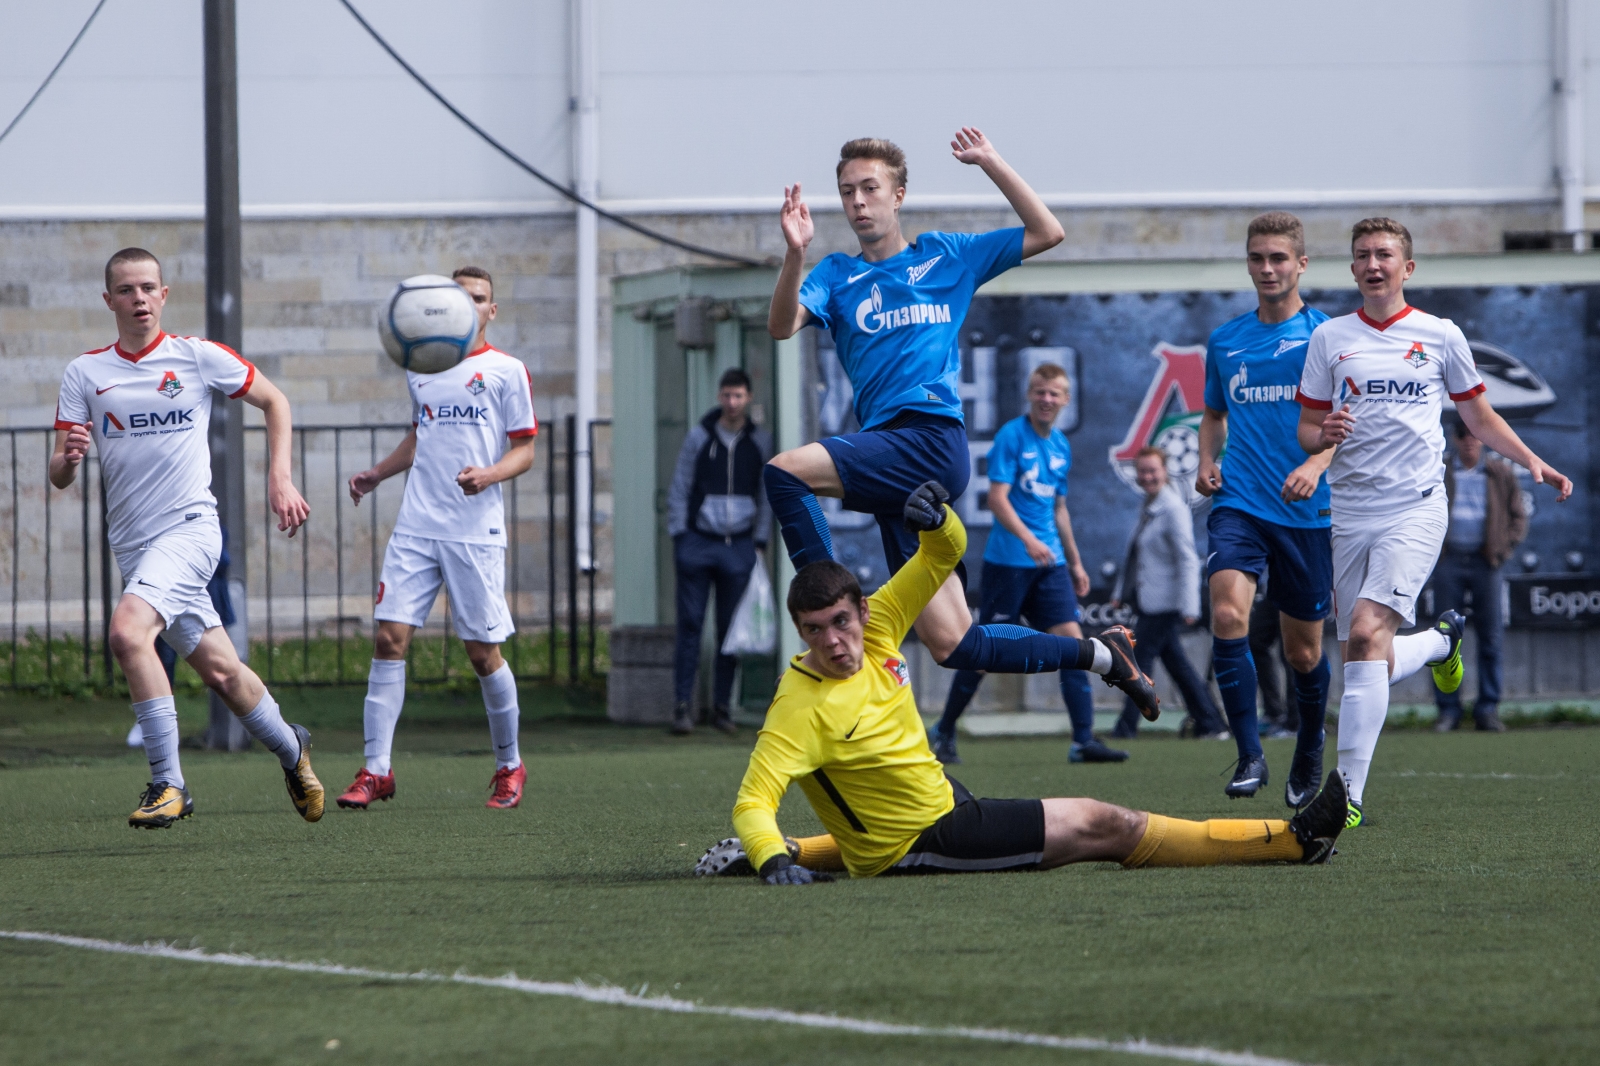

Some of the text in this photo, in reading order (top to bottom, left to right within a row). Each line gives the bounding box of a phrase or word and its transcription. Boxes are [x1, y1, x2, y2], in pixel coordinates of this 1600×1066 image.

[886, 304, 951, 330] ГАЗПРОМ
[1367, 380, 1429, 397] БМК
[129, 409, 194, 429] БМК
[438, 405, 488, 420] БМК
[130, 430, 157, 438] группа
